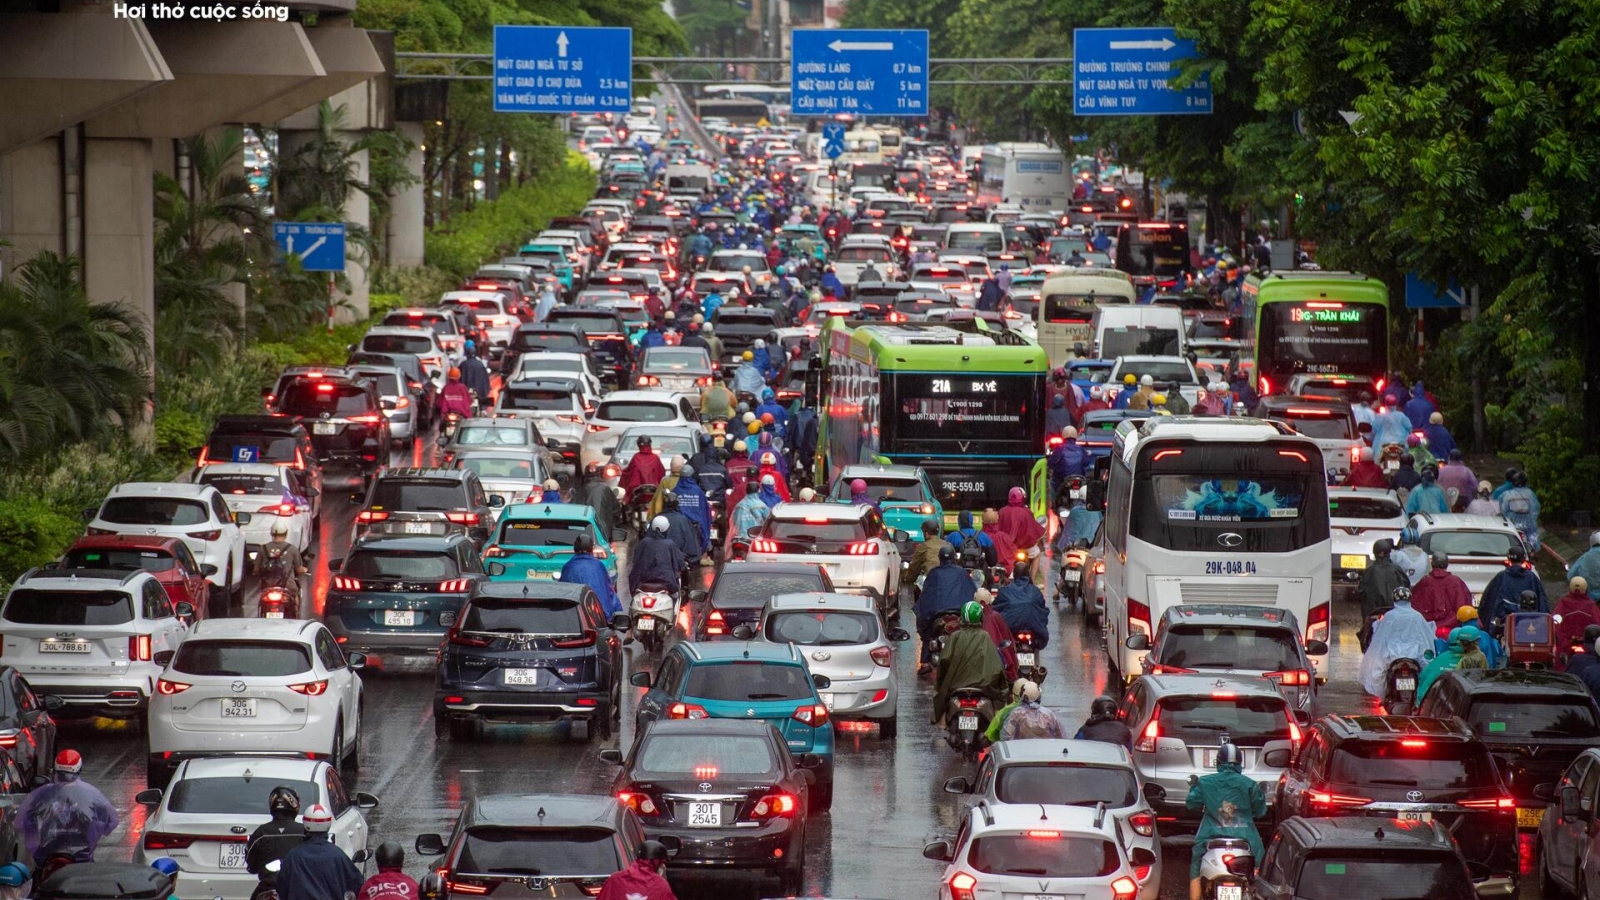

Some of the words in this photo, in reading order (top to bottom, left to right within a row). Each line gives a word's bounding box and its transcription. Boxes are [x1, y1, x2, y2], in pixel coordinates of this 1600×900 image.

[498, 57, 513, 69] NÚT
[515, 59, 535, 70] GIAO
[797, 61, 826, 73] ĐƯỜNG
[908, 63, 921, 73] km
[1110, 59, 1143, 73] TRƯỜNG
[1146, 62, 1170, 72] CHINH
[498, 74, 513, 87] NÚT
[515, 77, 535, 87] GIAO
[545, 78, 562, 89] CHỢ
[600, 79, 613, 89] 2.5
[615, 79, 628, 89] km
[816, 80, 835, 91] GIAO
[856, 77, 875, 91] GIẤY
[900, 80, 906, 91] 5
[908, 80, 921, 91] km
[1080, 78, 1095, 90] NÚT
[1097, 80, 1116, 90] GIAO
[537, 91, 560, 105] QUỐC
[574, 92, 595, 105] GIÁM
[600, 96, 613, 106] 4.3
[615, 96, 628, 106] km
[897, 98, 905, 108] 11
[908, 98, 921, 108] km
[1121, 97, 1137, 107] TUY
[1186, 97, 1191, 107] 8
[1194, 97, 1207, 106] km
[1291, 308, 1301, 321] 19
[1315, 309, 1337, 321] TRẦN
[932, 380, 950, 393] 21A
[972, 382, 984, 392] BX
[1205, 561, 1256, 575] 29K-048.04
[44, 643, 87, 651] 30L-788.61
[231, 700, 247, 708] 30G
[225, 708, 253, 716] 942.31
[695, 803, 715, 814] 30T
[692, 814, 718, 825] 2545
